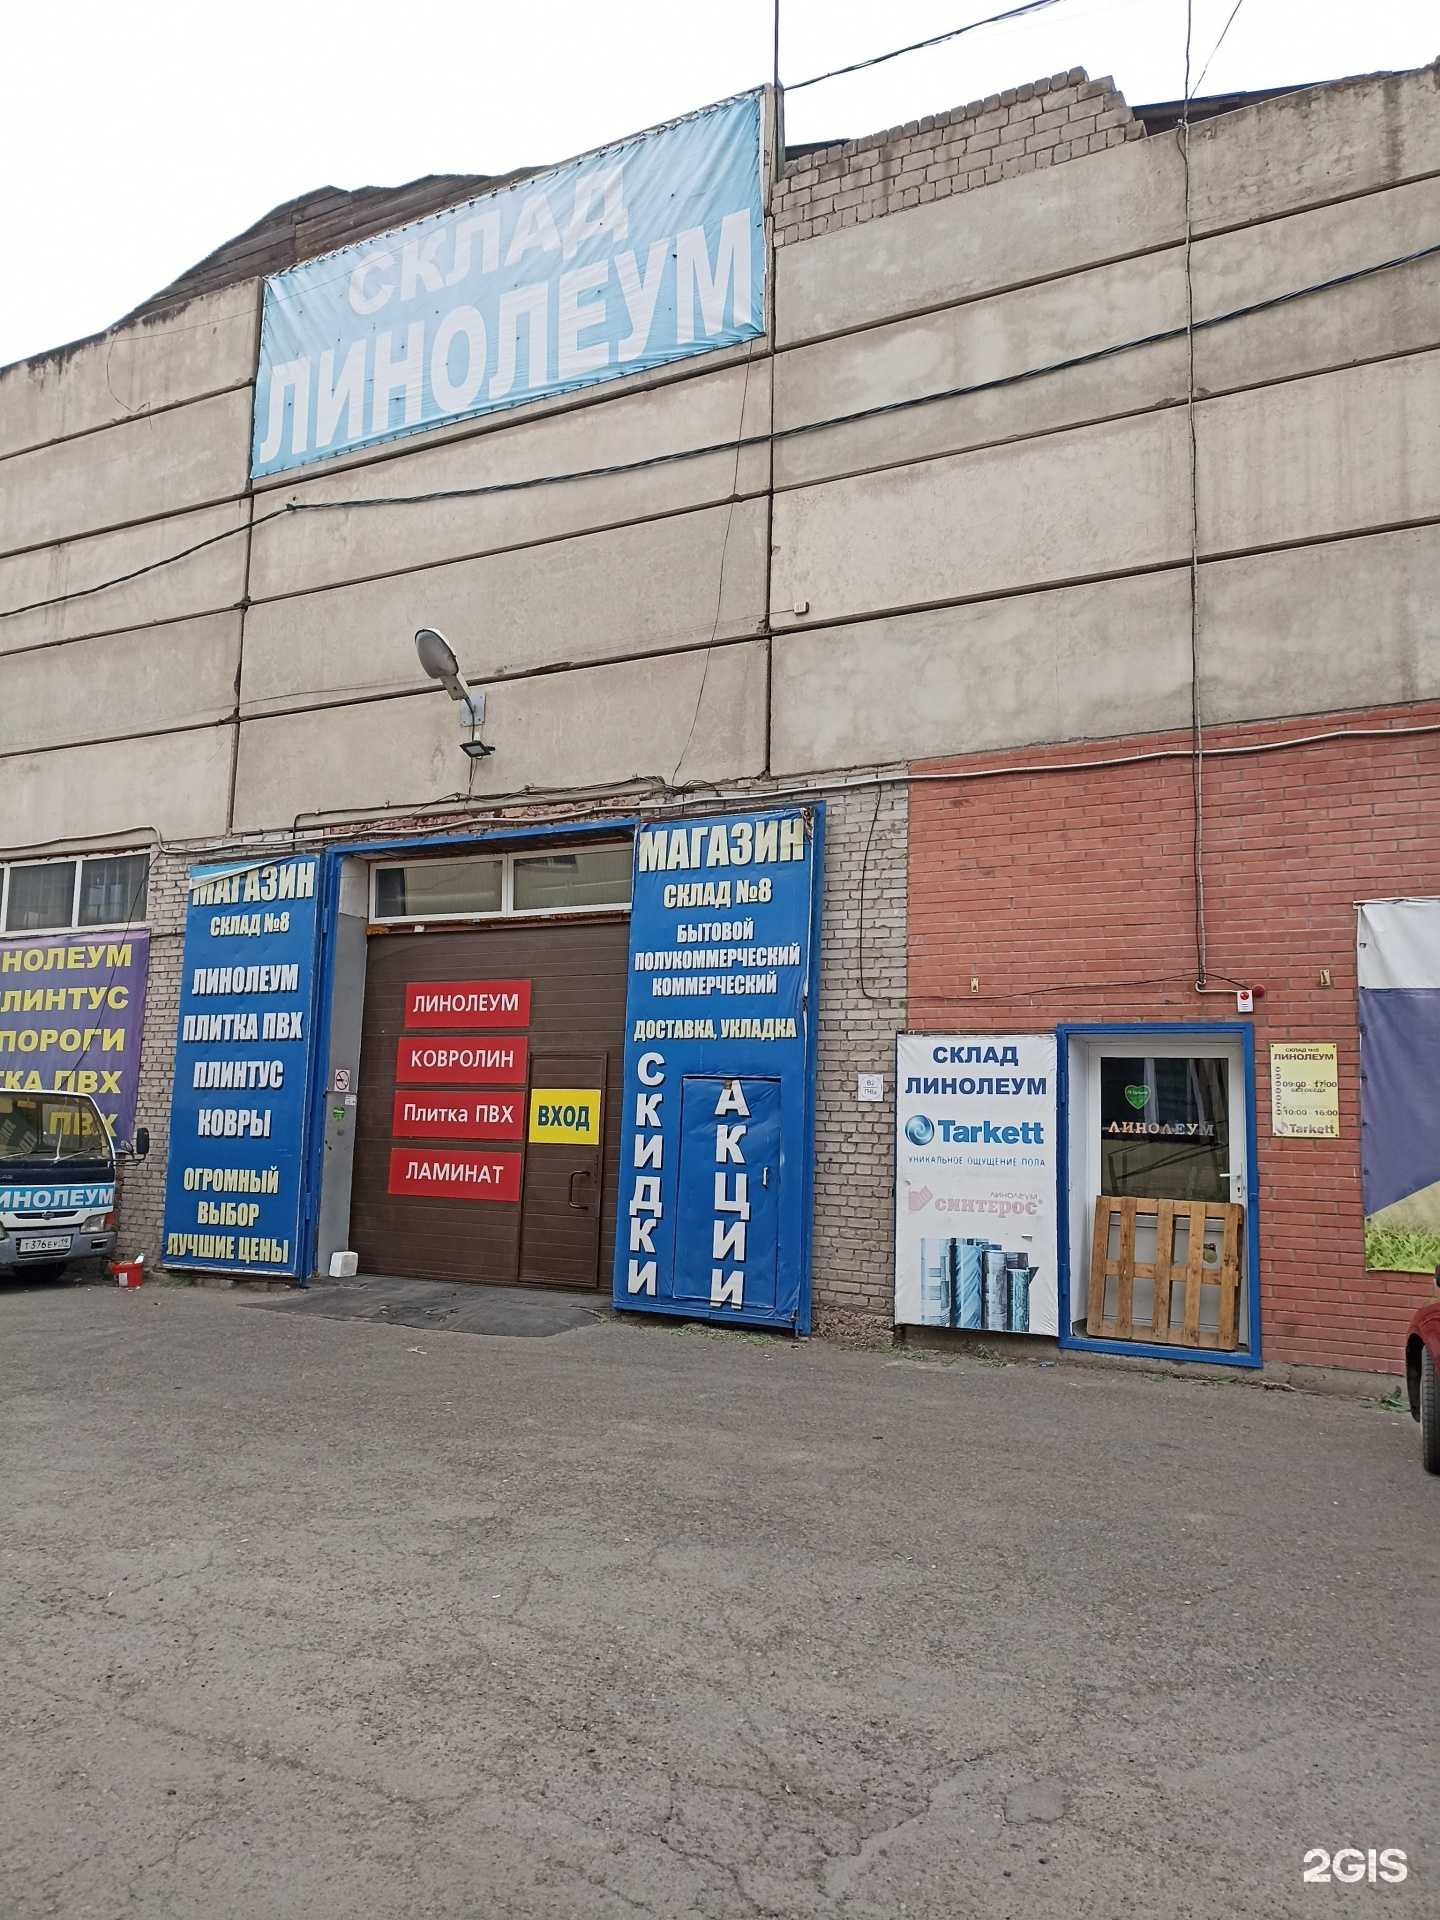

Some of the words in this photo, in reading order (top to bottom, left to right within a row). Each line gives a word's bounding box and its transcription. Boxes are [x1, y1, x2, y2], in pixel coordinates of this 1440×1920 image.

[349, 167, 628, 315] СКЛАД
[259, 208, 752, 464] ЛИНОЛЕУМ
[638, 818, 804, 872] МАГАЗИН
[663, 880, 731, 909] СКЛАД
[736, 878, 772, 904] №8
[210, 914, 261, 937] СКЛАД
[264, 911, 290, 933] №8
[677, 917, 754, 943] БЫТОВОЙ
[635, 942, 801, 971] ПОЛУКОММЕРЧЕСКИЙ
[192, 964, 299, 995] ЛИНОЛЕУМ
[652, 970, 777, 996] КОММЕРЧЕСКИЙ
[412, 993, 519, 1013] ЛИНОЛЕУМ
[183, 1013, 258, 1041] ПЛИТКА
[262, 1012, 303, 1040] ПВХ
[633, 1019, 717, 1042] ДОСТАВКА,
[720, 1018, 797, 1041] УКЛАДКА
[0, 1029, 126, 1052] ПОРОГИ
[411, 1049, 514, 1068] КОВРОЛИН
[932, 1046, 1019, 1066] СКЛАД
[1274, 1053, 1334, 1061] ЛИНОЛЕУМ
[54, 1071, 122, 1094] ПВХ
[193, 1060, 284, 1089] ПЛИНТУС
[905, 1077, 1047, 1095] ЛИНОЛЕУМ
[198, 1108, 272, 1137] КОВРЫ
[404, 1103, 468, 1122] Плитка
[475, 1105, 514, 1123] ПВХ
[537, 1105, 590, 1131] ВХОД
[938, 1119, 1044, 1145] Tarkett
[1108, 1121, 1215, 1137] ЛИНОЛЕУМ
[1289, 1123, 1335, 1134] Tarkett
[405, 1161, 504, 1184] ЛАМИНАТ
[627, 1052, 665, 1296] СКИДКИ
[908, 1156, 963, 1165] УНИКАЛЬНОЕ
[967, 1157, 1017, 1167] ОЩУЩЕНИЕ
[1021, 1159, 1045, 1167] ПОЛА
[183, 1165, 279, 1193] ОГРОМНЫЙ
[710, 1080, 750, 1310] АКЦИИ
[197, 1201, 260, 1226] ВЫБОР
[166, 1233, 235, 1259] ЛУЧШИЕ
[238, 1236, 289, 1264] ЦЕНЫ
